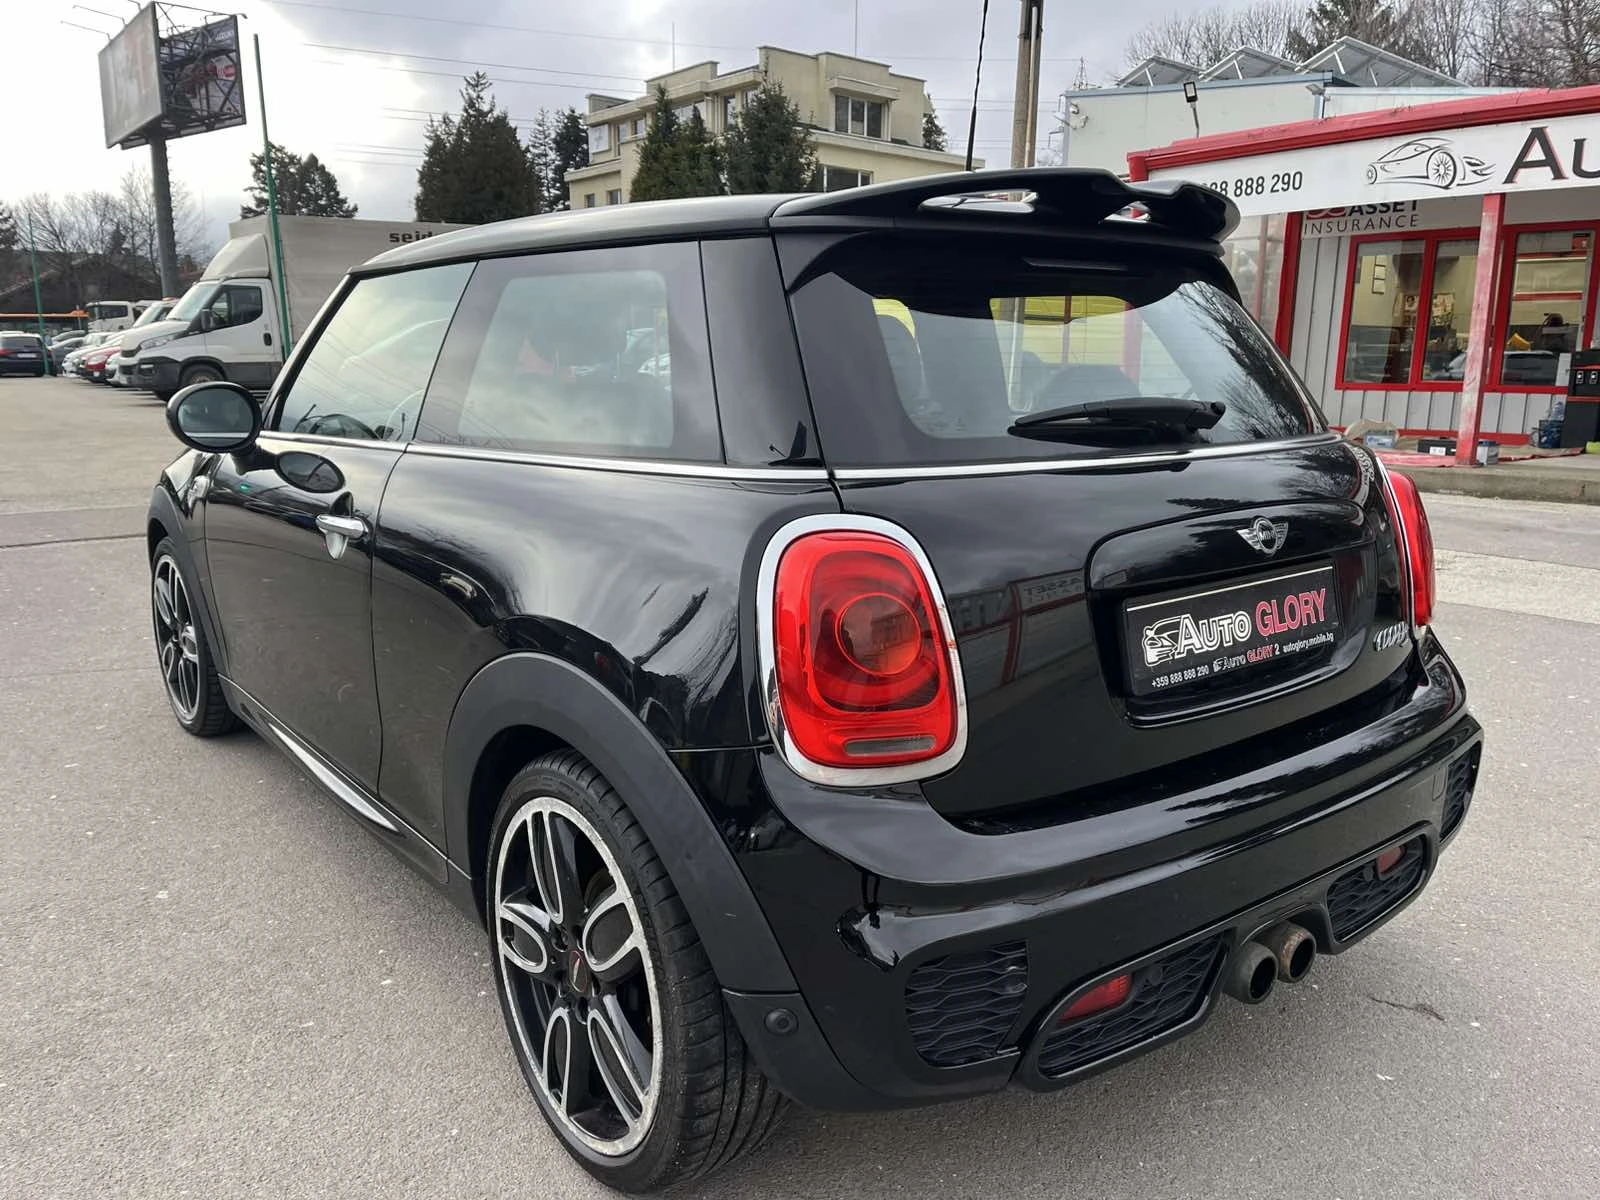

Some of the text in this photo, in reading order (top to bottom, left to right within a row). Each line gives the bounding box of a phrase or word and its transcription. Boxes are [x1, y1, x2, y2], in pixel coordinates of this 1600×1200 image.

[1234, 176, 1265, 197] 888
[1270, 171, 1303, 193] 290
[1304, 214, 1419, 235] INSURANCE
[1176, 611, 1251, 658] AUTO
[1256, 588, 1326, 637] GLORY
[1151, 675, 1169, 688] +359
[1169, 671, 1183, 684] 888
[1183, 668, 1197, 680] 888
[1197, 664, 1209, 677] 290
[1247, 645, 1273, 663] GLORY
[1274, 643, 1280, 655] 2
